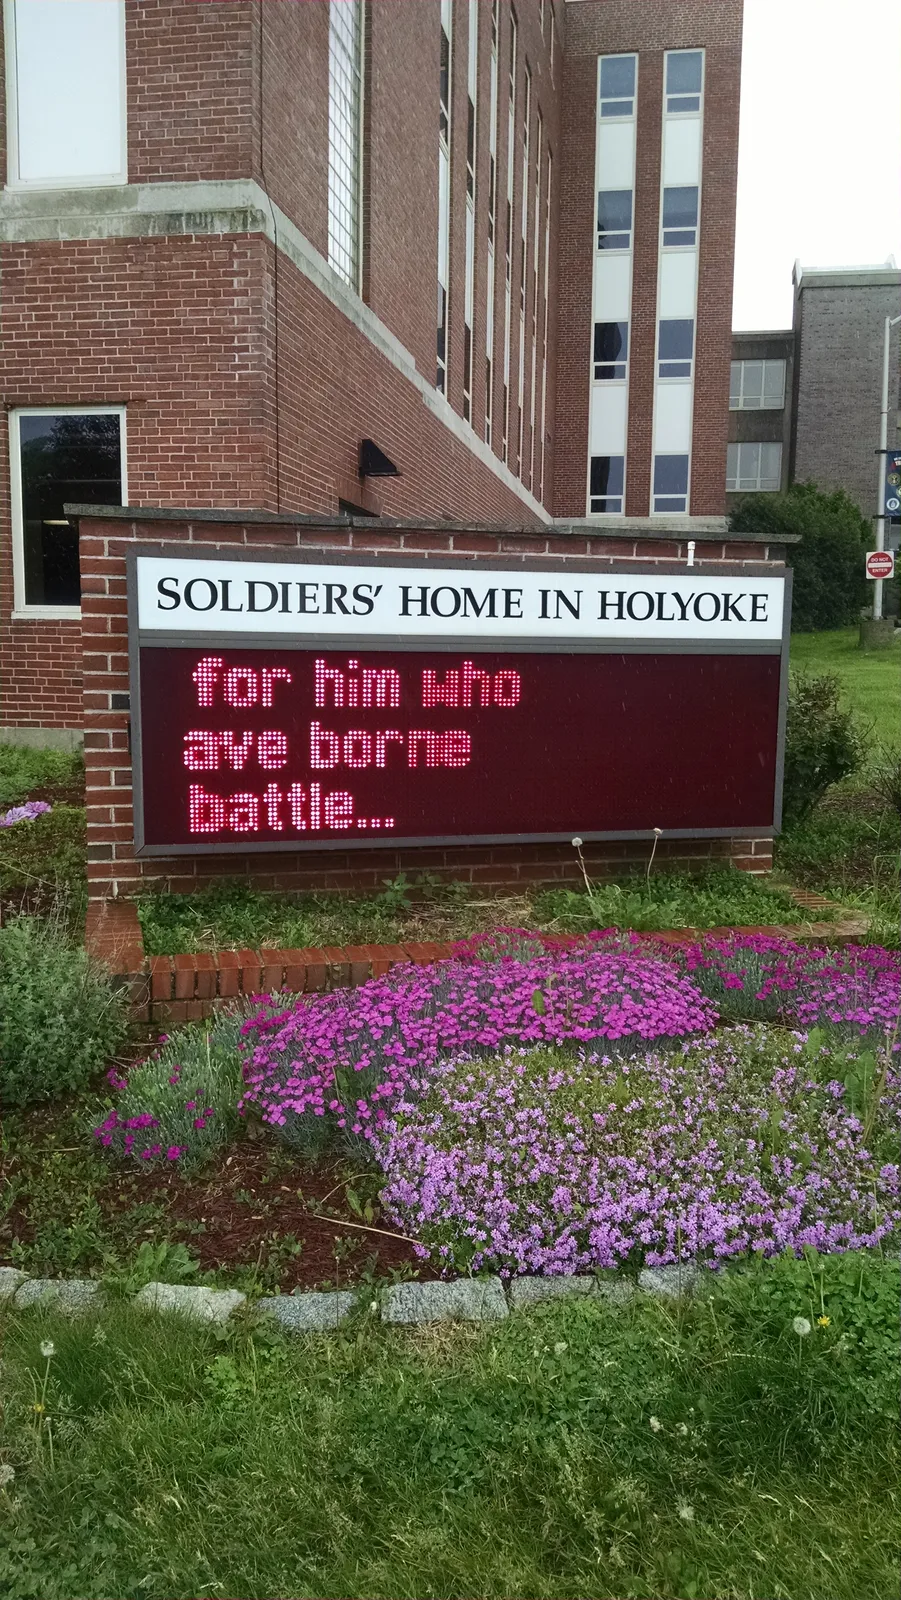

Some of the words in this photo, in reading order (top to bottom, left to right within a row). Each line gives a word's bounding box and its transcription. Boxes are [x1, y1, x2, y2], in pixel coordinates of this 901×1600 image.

[398, 585, 523, 619] HOME
[537, 589, 583, 620] IN
[597, 590, 769, 622] HOLYOKE
[192, 657, 292, 707] for
[315, 659, 400, 707] him
[422, 660, 521, 707] who
[183, 729, 288, 770] ave
[189, 782, 395, 833] battle...
